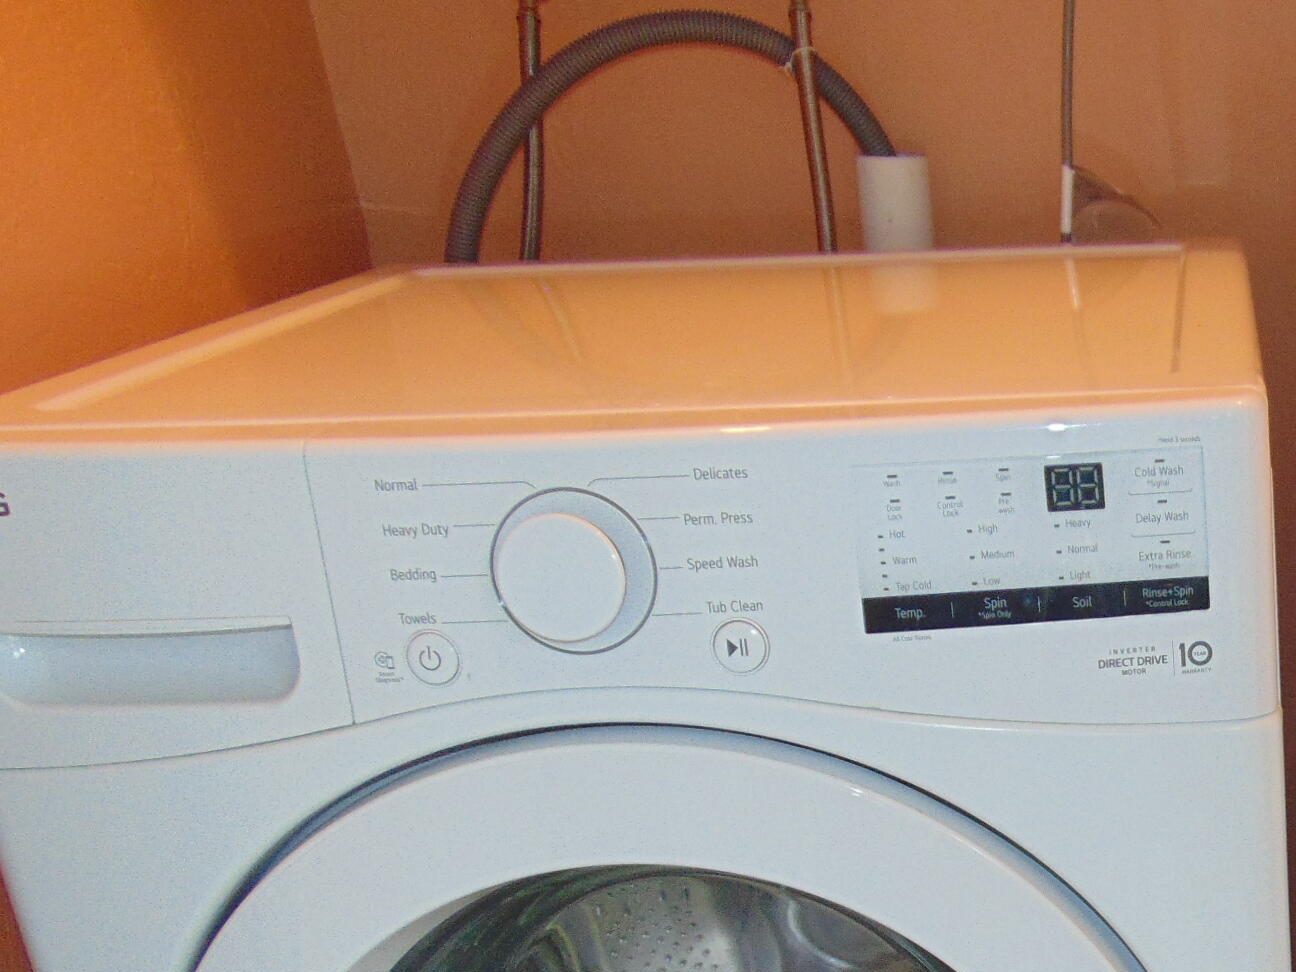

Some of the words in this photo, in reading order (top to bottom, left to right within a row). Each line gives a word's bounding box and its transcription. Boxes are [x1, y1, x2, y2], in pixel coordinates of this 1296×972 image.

[693, 467, 749, 480] Delicates
[1134, 466, 1156, 478] Cold
[1160, 464, 1184, 476] Wash
[374, 478, 418, 492] Normal
[683, 513, 717, 526] Perm.
[720, 511, 753, 524] Press
[1065, 519, 1091, 530] Heavy
[1135, 513, 1161, 525] Delay
[1164, 511, 1189, 521] Wash
[382, 523, 417, 540] Heavy
[421, 522, 449, 538] Duty
[889, 529, 906, 539] Hot
[978, 524, 998, 536] High
[981, 550, 1015, 560] Medium
[1067, 543, 1098, 554] Normal
[892, 556, 917, 566] Warm
[1138, 551, 1163, 562] Extra
[1166, 549, 1192, 560] Rinse
[686, 557, 723, 573] Speed
[727, 555, 759, 568] Wash
[390, 568, 437, 583] Bedding
[983, 576, 1001, 586] Low
[1069, 570, 1091, 582] Light
[896, 583, 910, 593] Tap
[912, 580, 932, 590] Cold
[1142, 585, 1194, 599] Rinse+Spin
[706, 600, 727, 614] Tub
[730, 600, 764, 613] Clean
[984, 596, 1007, 611] Spin
[1072, 596, 1093, 608] Soil
[398, 612, 437, 625] Towels
[894, 607, 926, 621] Temp.
[1109, 646, 1156, 655] INVERTER
[1179, 640, 1213, 668] 10
[1098, 657, 1135, 669] DIRECT
[1137, 655, 1168, 667] DRIVE
[1121, 668, 1147, 676] MOTOR
